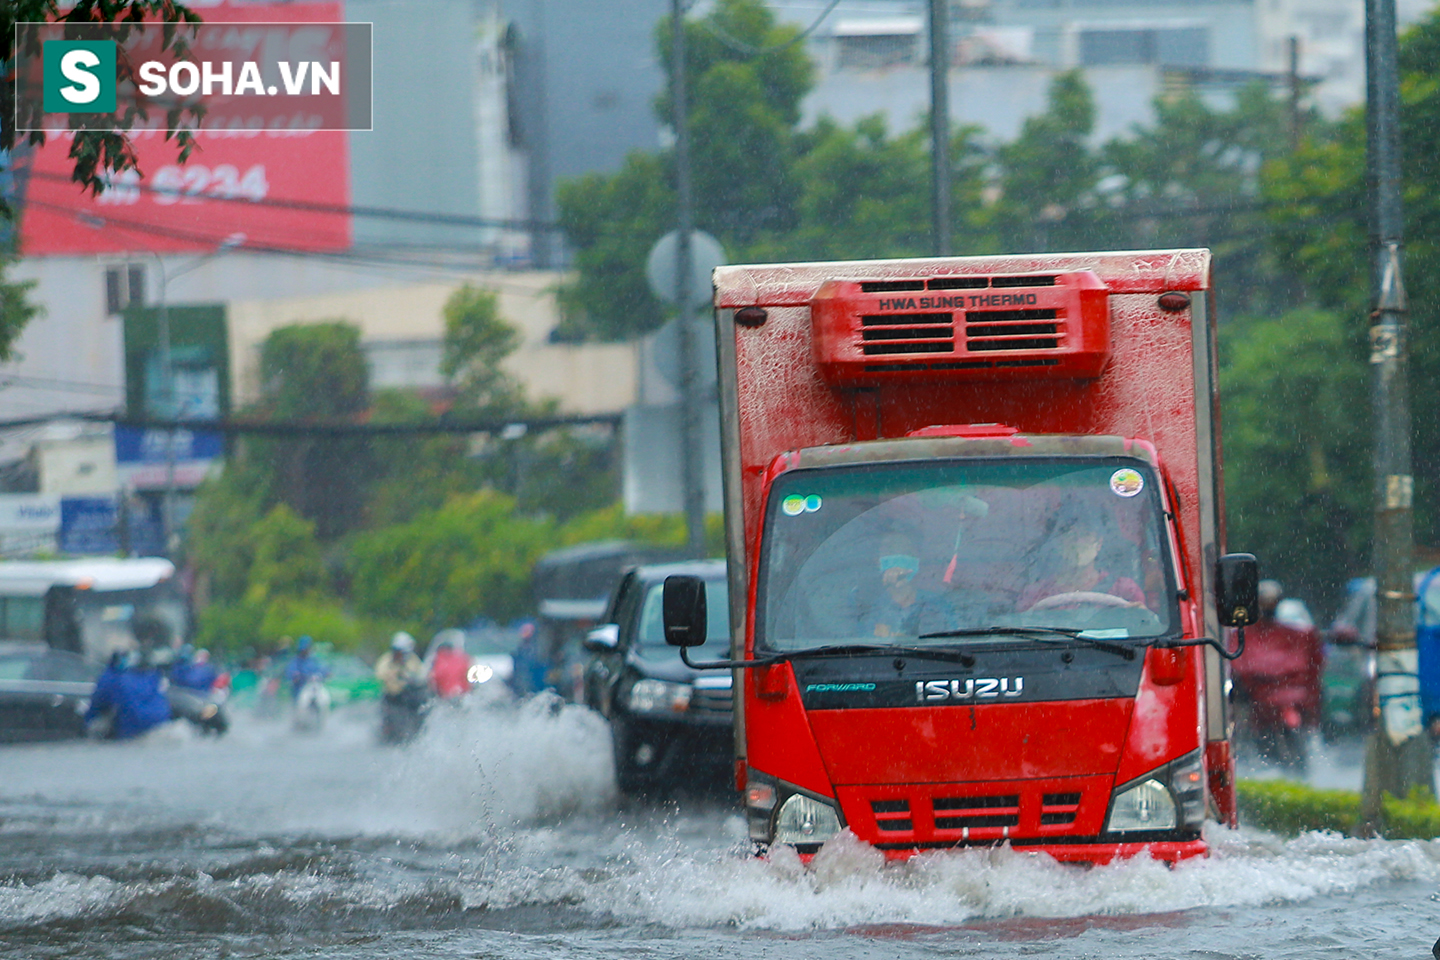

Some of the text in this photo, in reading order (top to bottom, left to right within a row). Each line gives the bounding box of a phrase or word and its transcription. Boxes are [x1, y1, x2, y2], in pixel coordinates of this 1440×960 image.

[879, 293, 1037, 311] HWA SUNG THERMO
[806, 677, 1024, 701] FORWARD ISUZU
